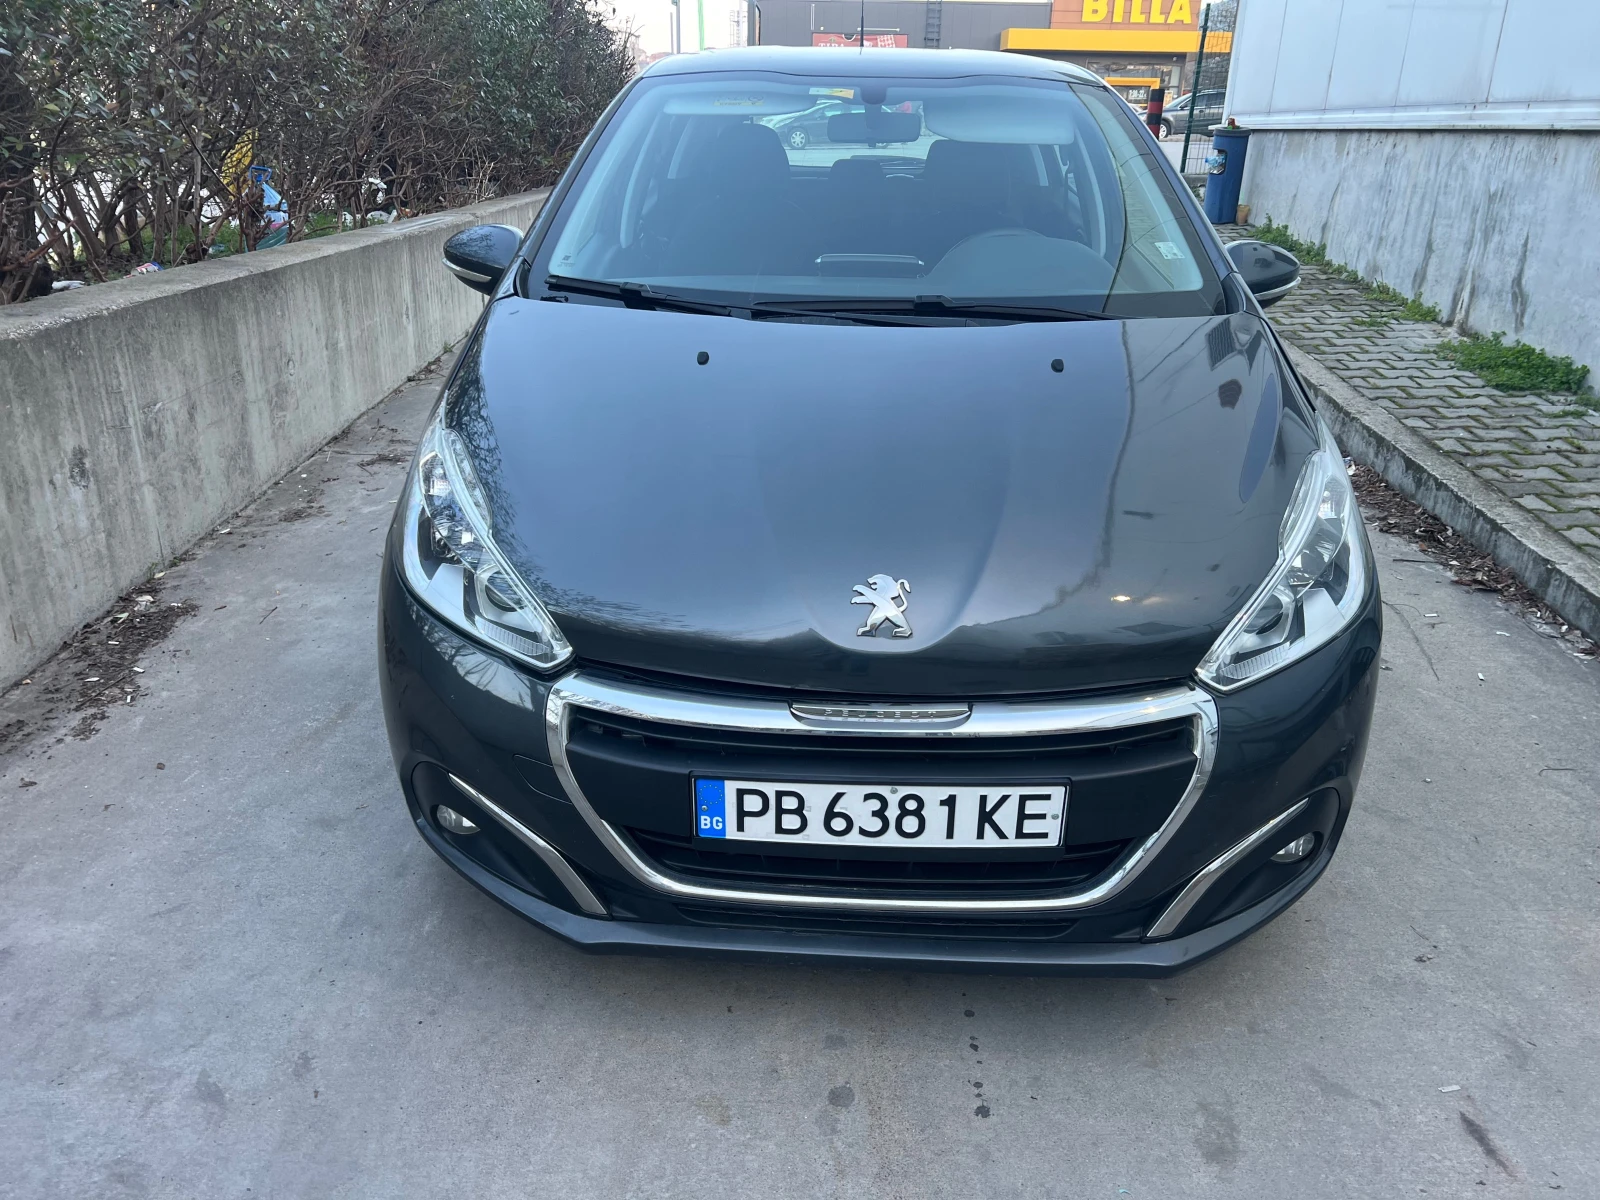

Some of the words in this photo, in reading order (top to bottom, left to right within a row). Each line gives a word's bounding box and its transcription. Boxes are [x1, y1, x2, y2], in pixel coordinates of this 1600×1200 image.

[1081, 0, 1192, 24] BILLA
[700, 815, 723, 830] BG
[735, 787, 808, 836] PB
[823, 792, 957, 839] 6381
[975, 793, 1052, 841] KE
